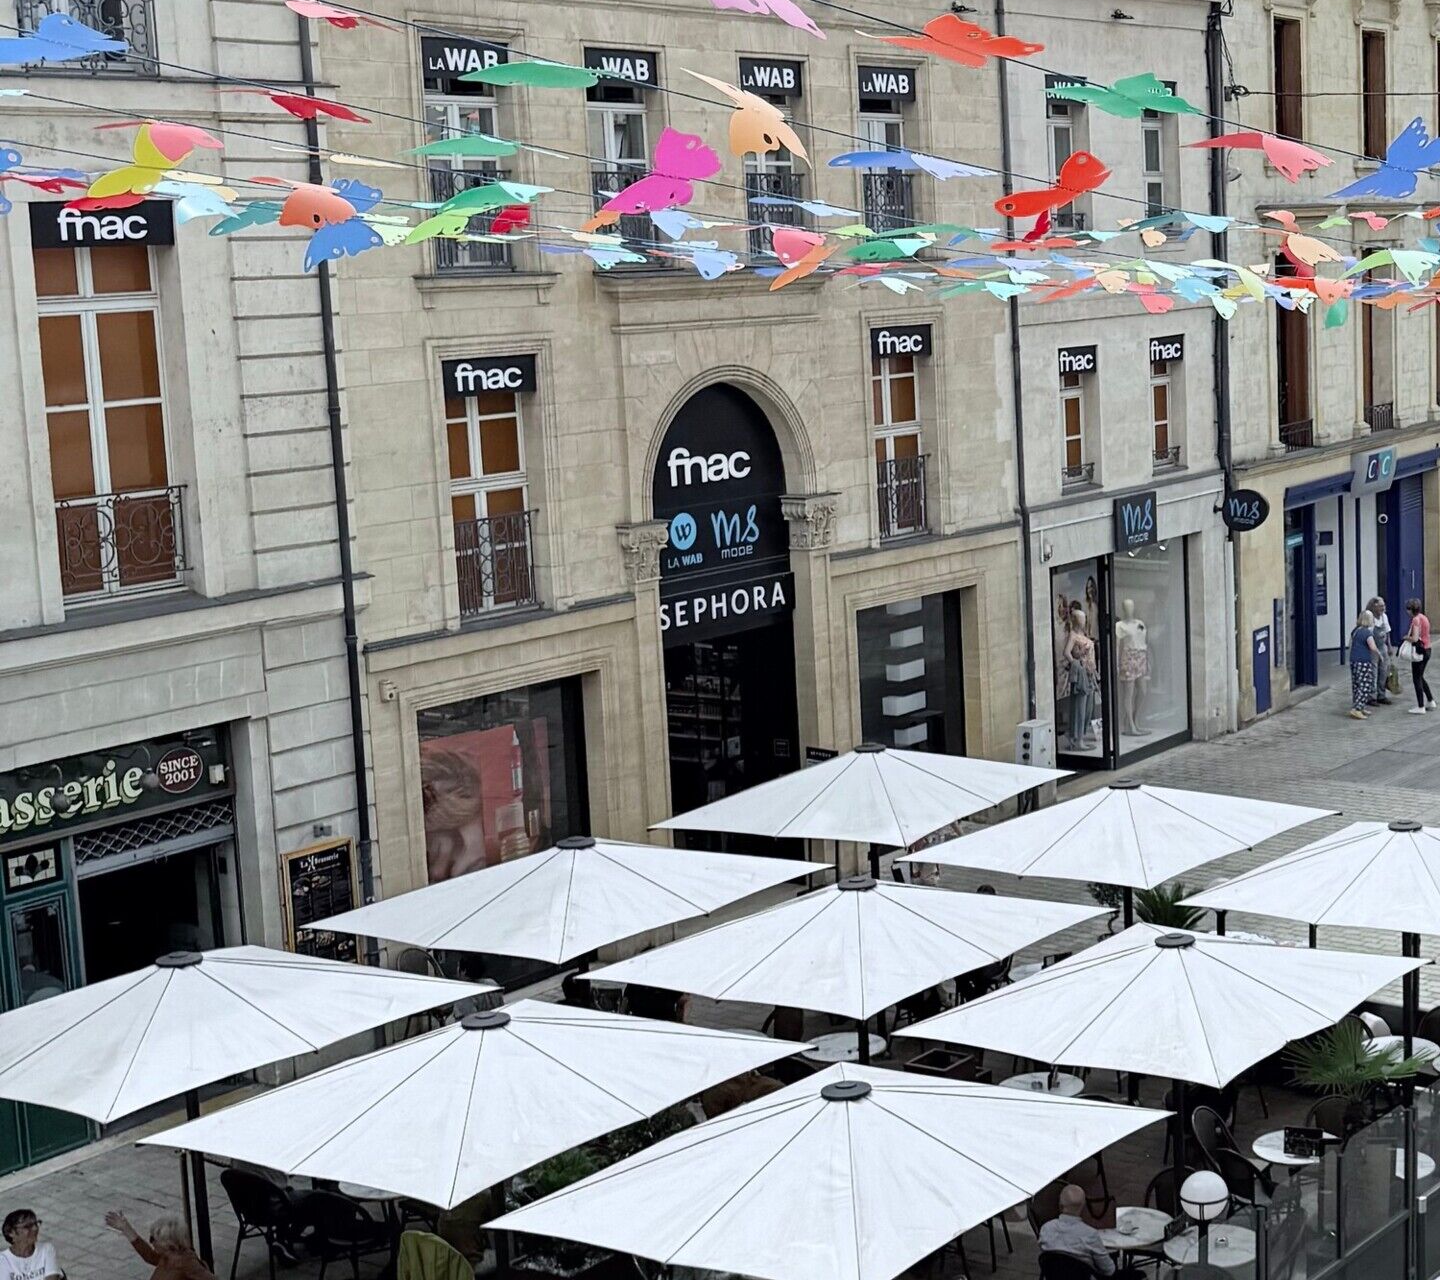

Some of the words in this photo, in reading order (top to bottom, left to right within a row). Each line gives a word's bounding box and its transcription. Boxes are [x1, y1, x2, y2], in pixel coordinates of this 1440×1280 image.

[429, 57, 445, 70] LA
[602, 56, 650, 81] WAB
[743, 74, 754, 86] LA
[753, 66, 795, 88] WAB
[862, 81, 873, 92] LA
[872, 73, 909, 94] WAB
[57, 207, 148, 241] fnac
[878, 330, 923, 355] fnac
[1151, 340, 1181, 361] fnac
[1059, 351, 1094, 373] fnac
[454, 363, 523, 392] fnac
[667, 447, 751, 487] fnac
[667, 557, 680, 569] LA
[682, 552, 703, 566] WAB
[660, 581, 786, 631] SEPHORA
[159, 754, 199, 774] SINCE
[165, 768, 196, 786] 2001
